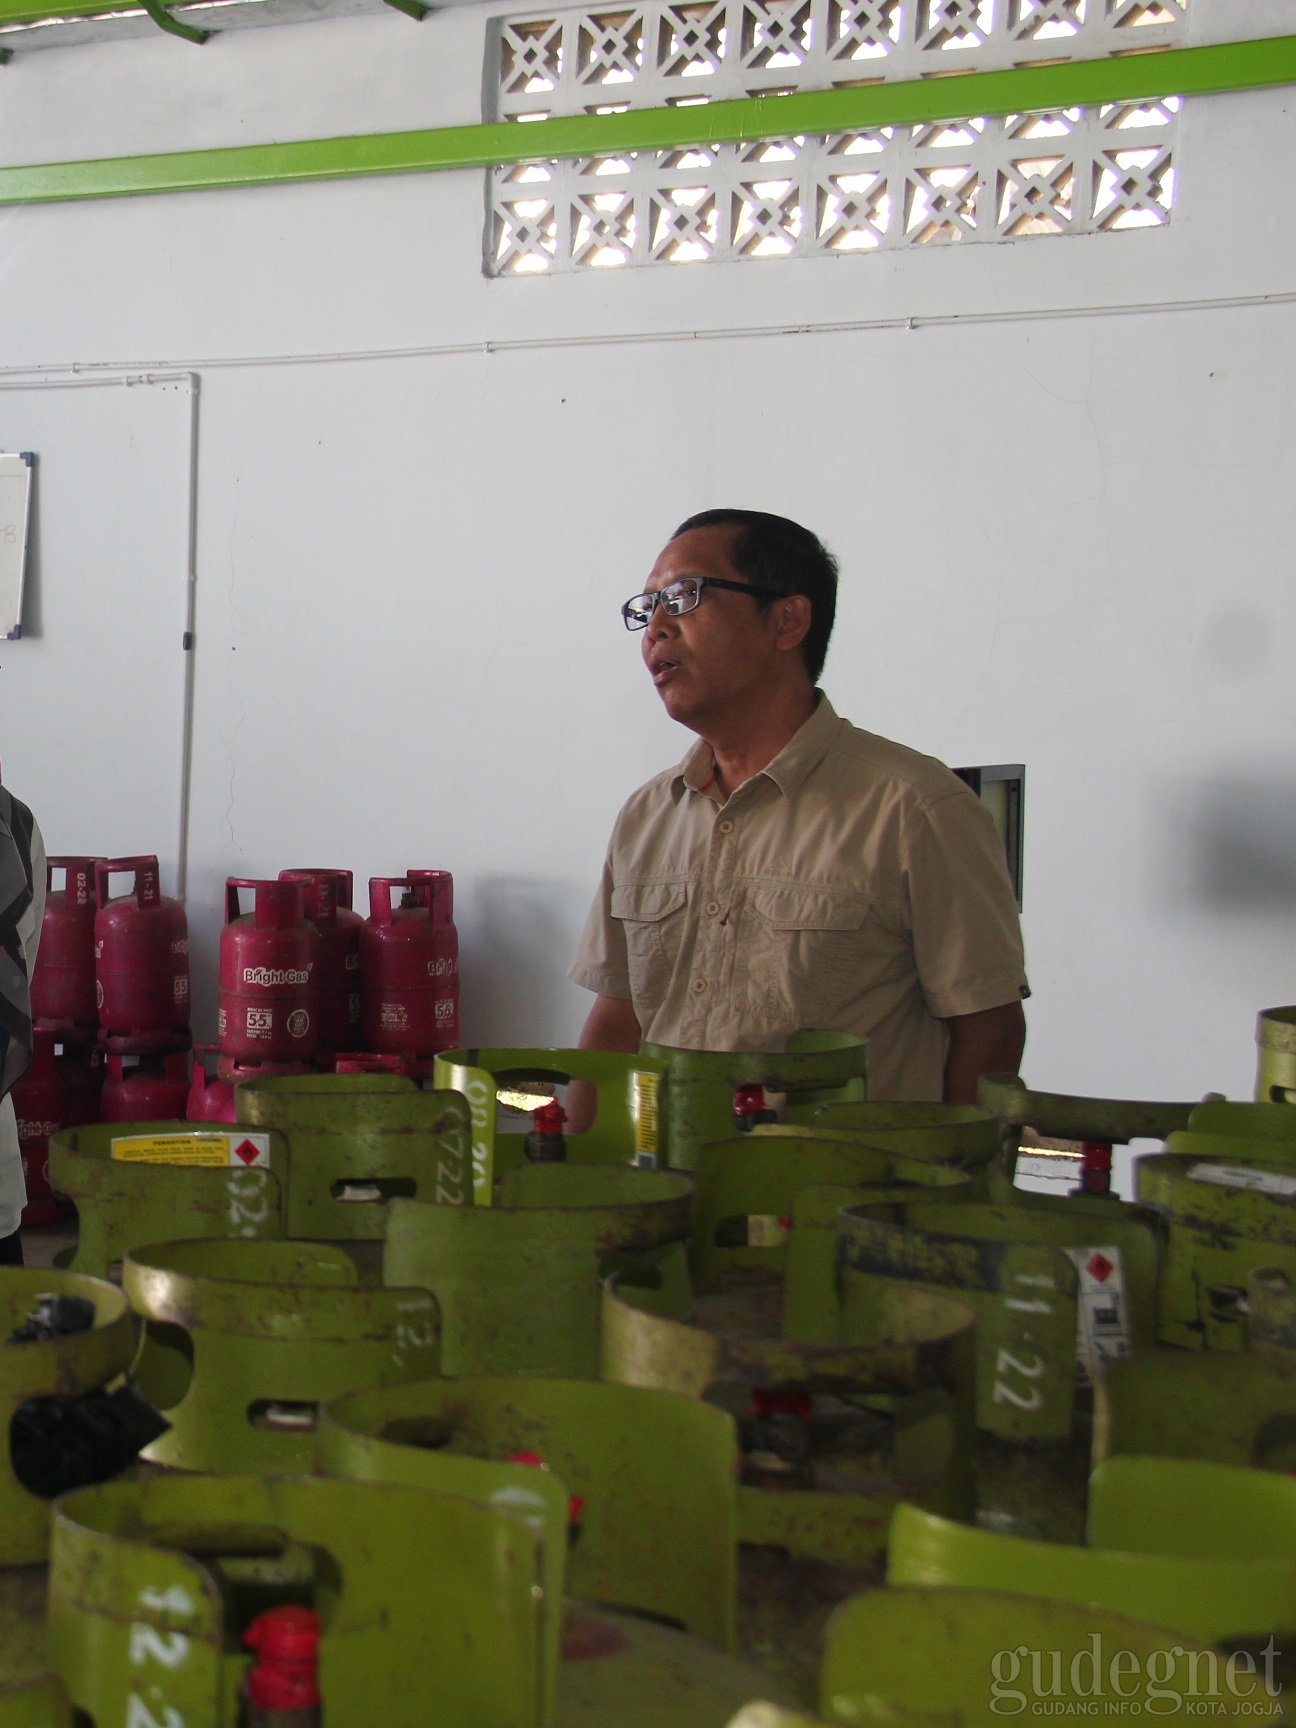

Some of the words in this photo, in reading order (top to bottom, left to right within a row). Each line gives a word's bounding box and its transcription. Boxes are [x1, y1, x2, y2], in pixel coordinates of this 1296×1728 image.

[244, 966, 285, 987] Bright
[286, 969, 309, 984] Gas
[128, 1585, 193, 1728] 12.2
